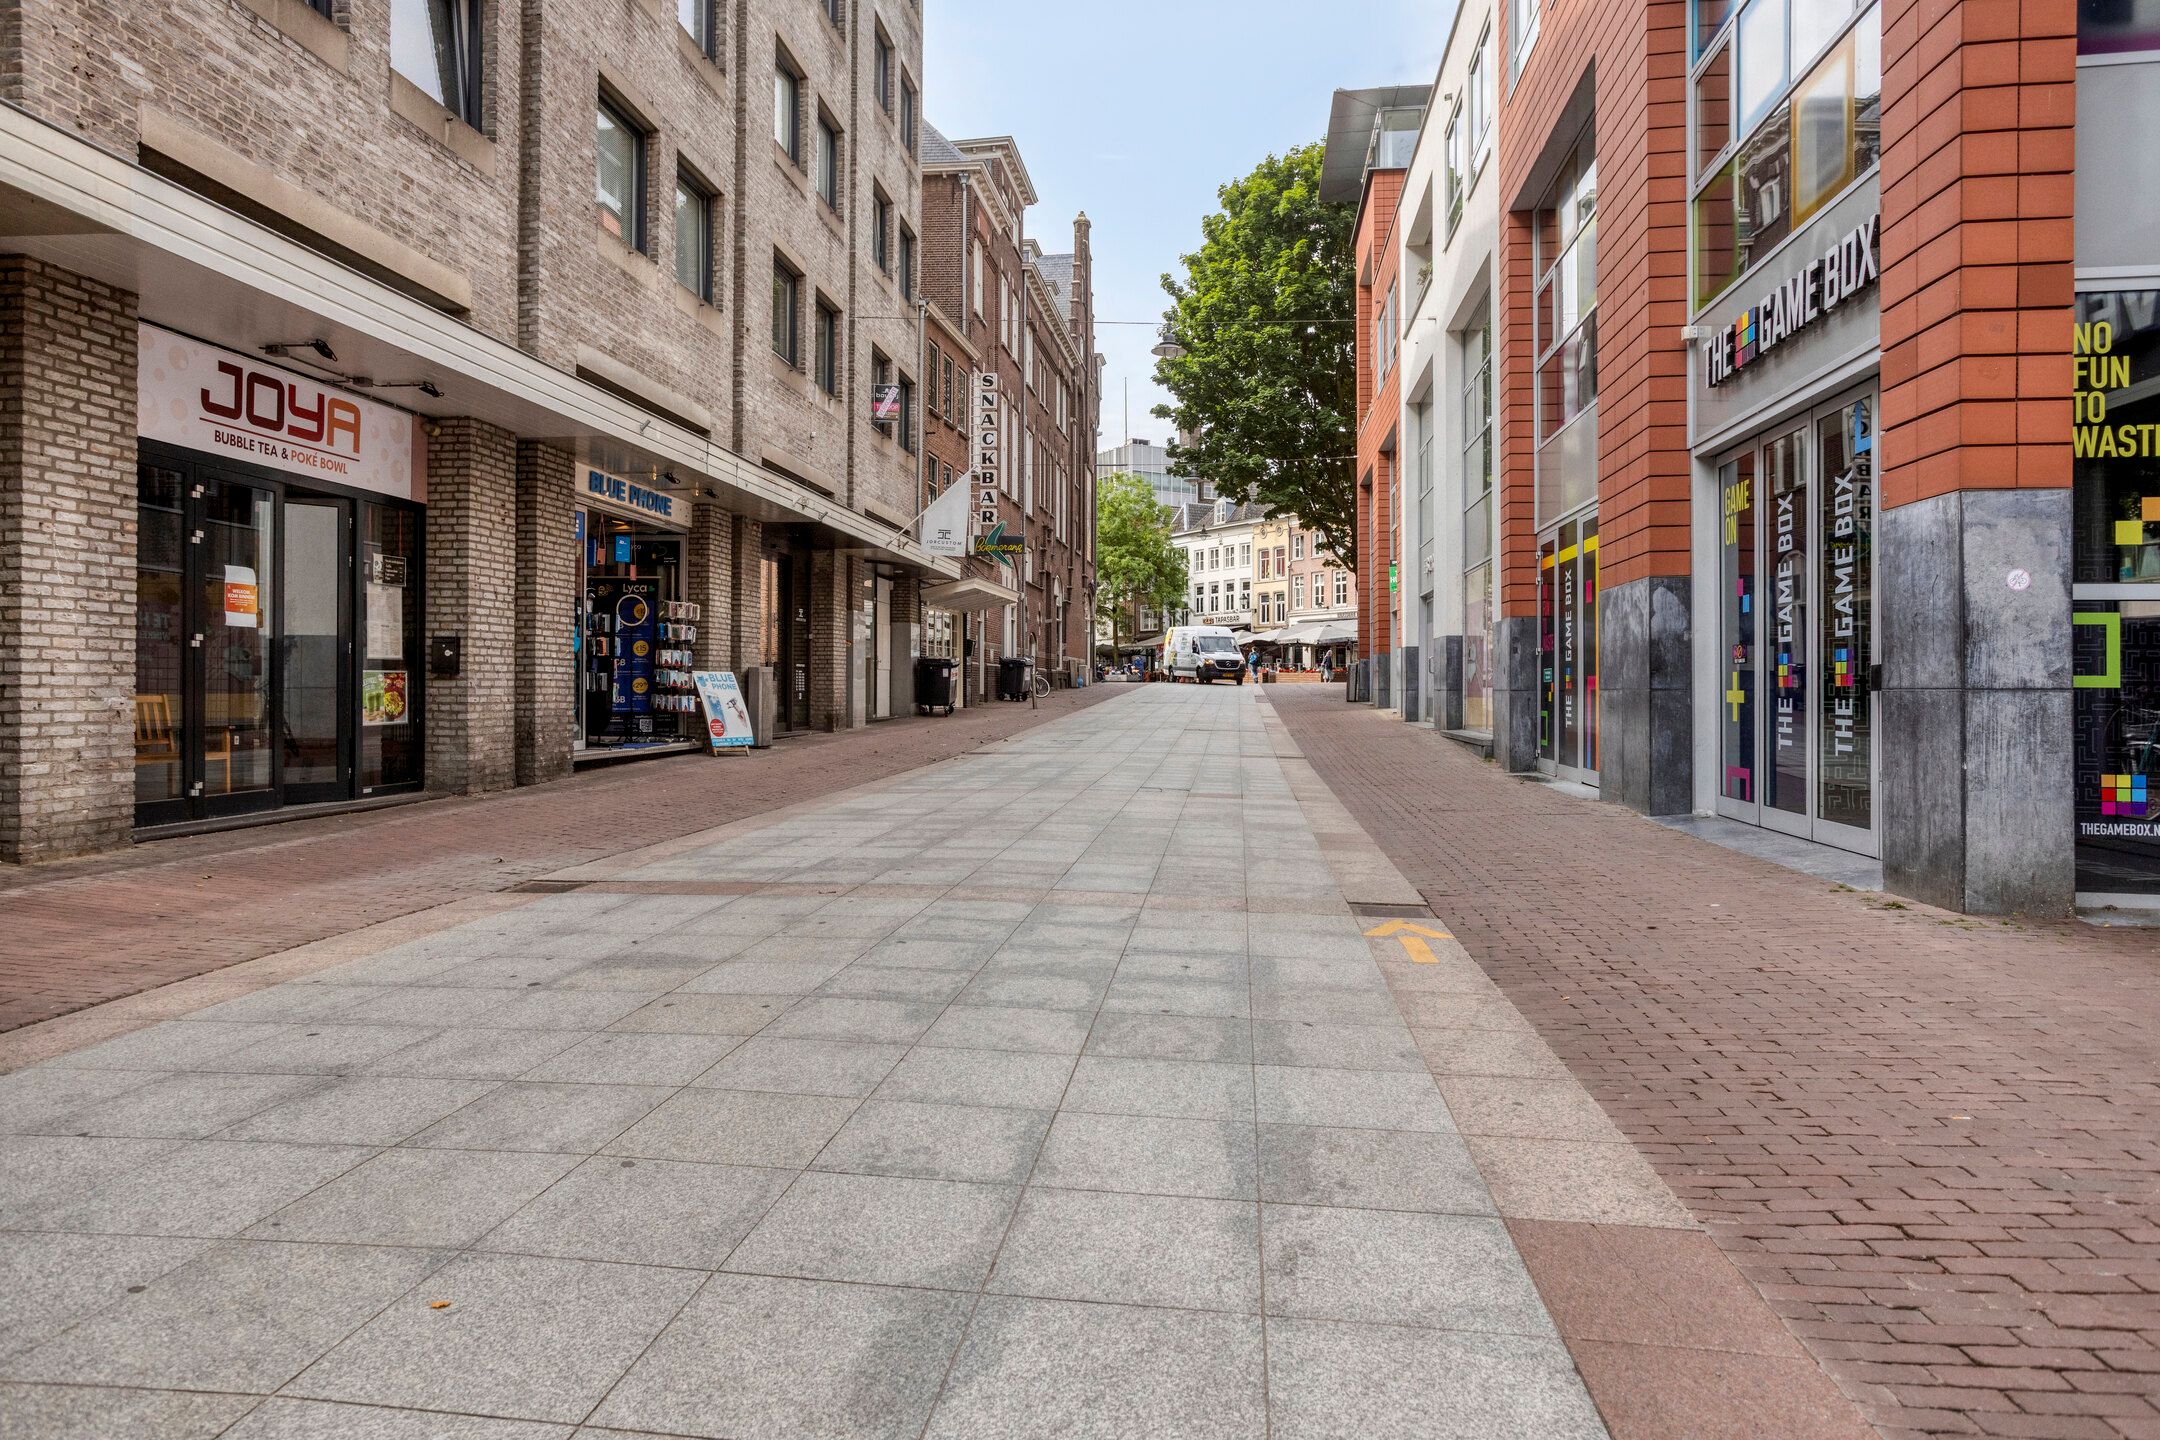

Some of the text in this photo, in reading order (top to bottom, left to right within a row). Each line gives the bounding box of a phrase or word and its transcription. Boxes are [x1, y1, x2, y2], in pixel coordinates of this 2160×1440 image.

[1703, 214, 1880, 389] THE GAME BOX
[2073, 322, 2111, 354] NO
[2073, 355, 2129, 388] FUN
[201, 360, 360, 453] JOYA
[2073, 391, 2106, 423] TO
[214, 430, 348, 474] BUBBLE TEA & POKÉ BOWL
[981, 375, 995, 523] SNACKBAR
[590, 470, 672, 516] BLUE PHONE
[1725, 479, 1750, 516] GAME
[1725, 514, 1737, 545] ON
[623, 584, 647, 594] Lyca
[1215, 615, 1240, 624] TAPASBAR
[1778, 492, 1793, 750] THE GAME BOX
[1835, 469, 1853, 756] THE GAME BOX
[1565, 568, 1573, 728] THE GAME BOX
[708, 673, 735, 682] BLUE
